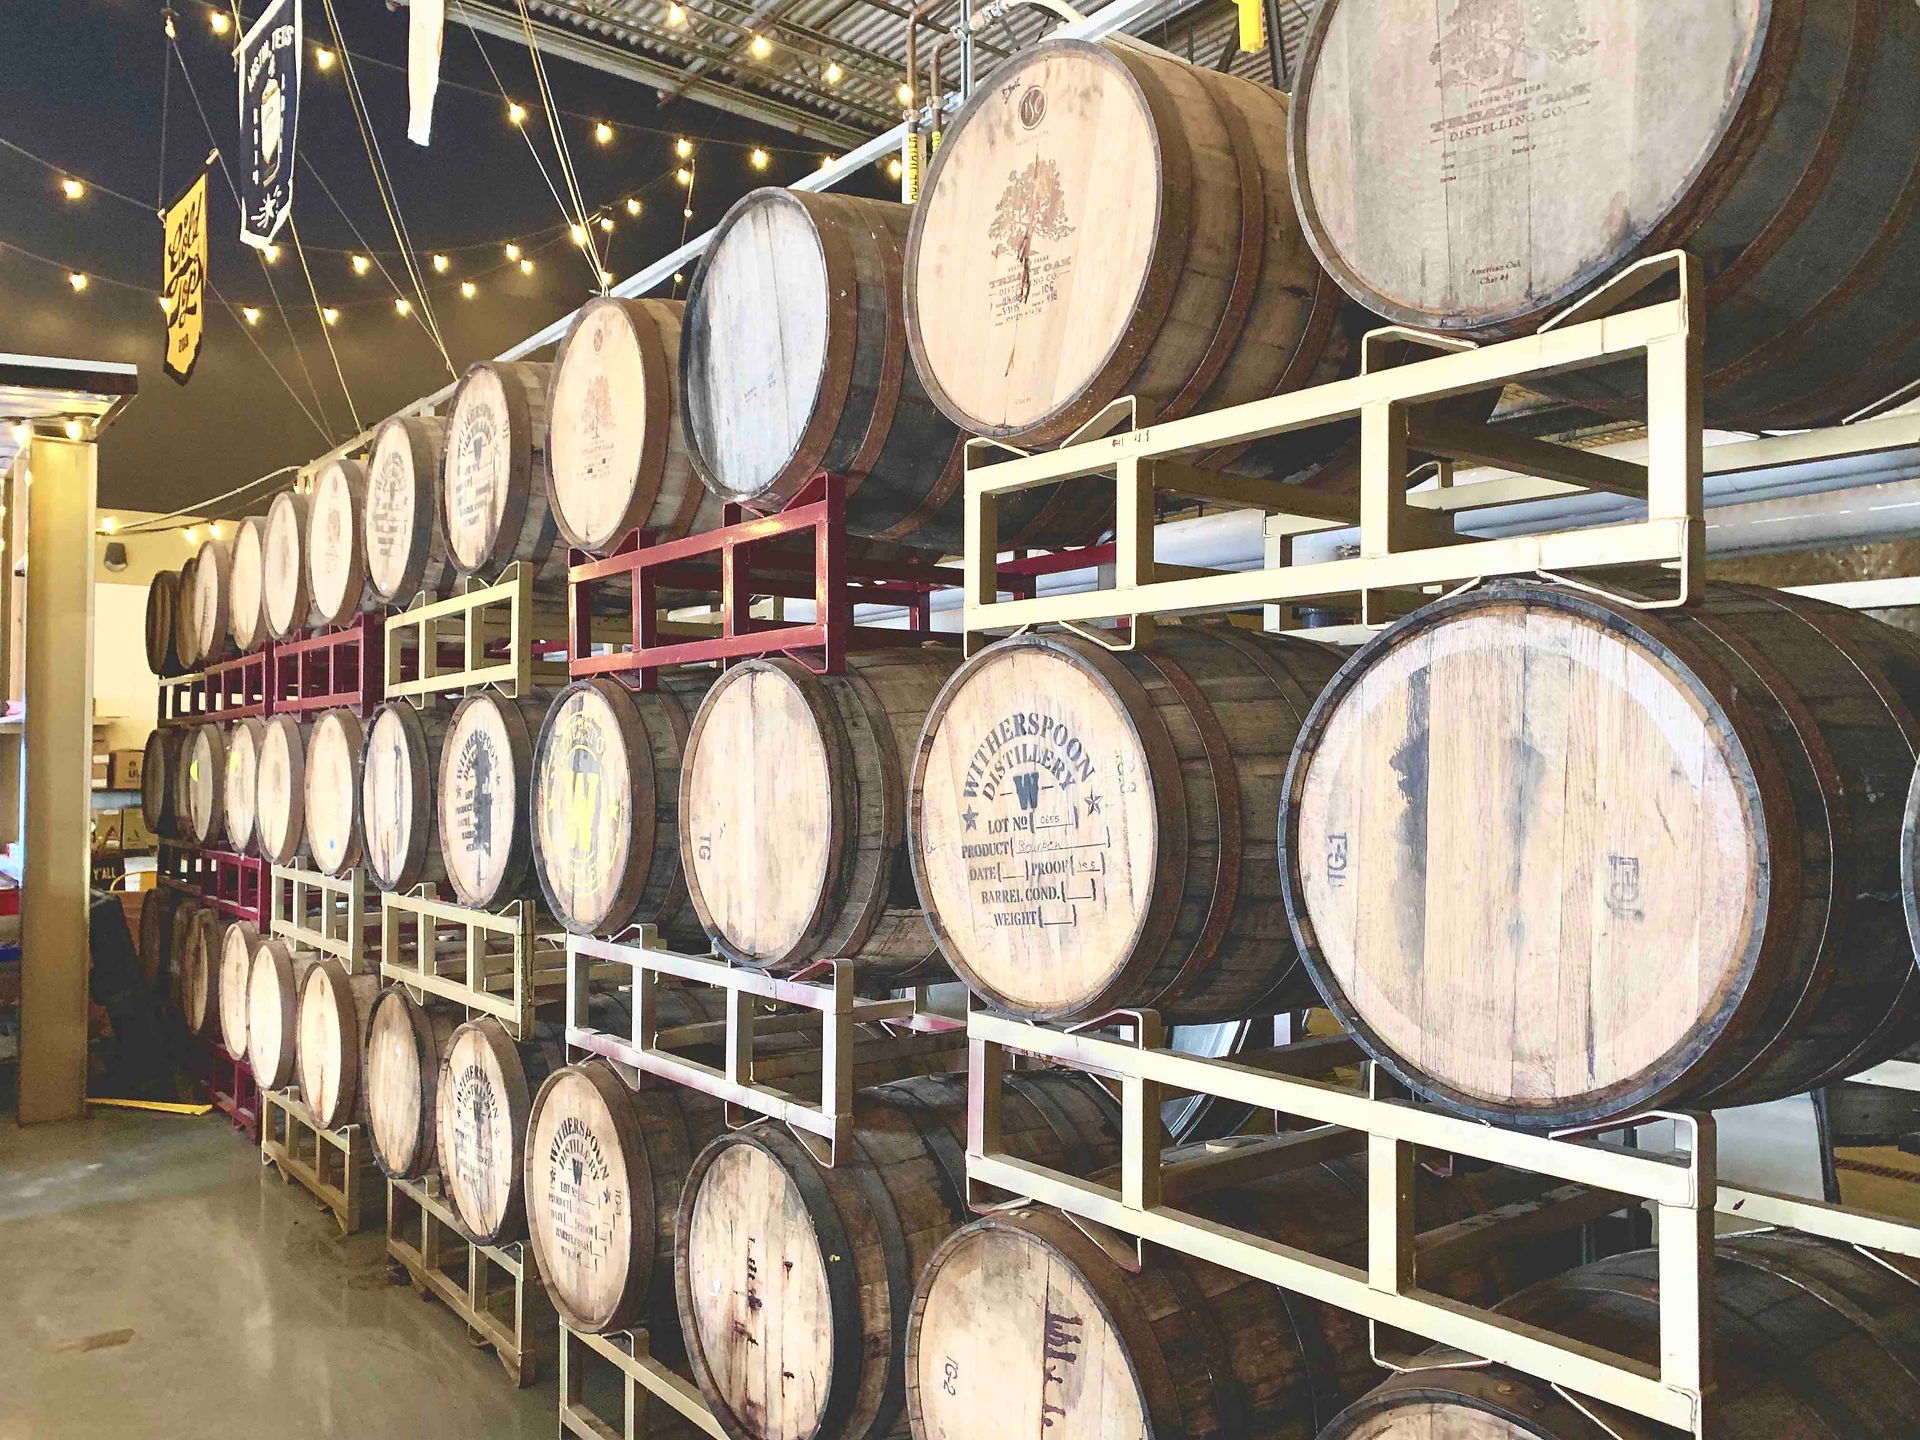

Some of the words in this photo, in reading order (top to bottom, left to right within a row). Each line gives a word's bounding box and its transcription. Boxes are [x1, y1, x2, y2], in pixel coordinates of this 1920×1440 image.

[1449, 112, 1536, 143] DISTILLING
[1541, 106, 1567, 119] CO.
[988, 265, 1042, 289] TREAY
[1468, 265, 1504, 276] American
[962, 712, 1097, 798] WITHERSPOON
[982, 743, 1076, 802] DISTILLERY
[1012, 771, 1040, 811] W
[988, 818, 1009, 835] LOT
[961, 841, 1010, 859] PRODUCT
[92, 866, 117, 880] Y'ALL
[968, 866, 997, 881] DATE
[1031, 859, 1069, 877] PROOF
[981, 888, 1023, 905] BARREL
[1025, 886, 1061, 902] COND.
[993, 911, 1037, 927] WEIGHT
[549, 1116, 610, 1181] WITHERSPOON
